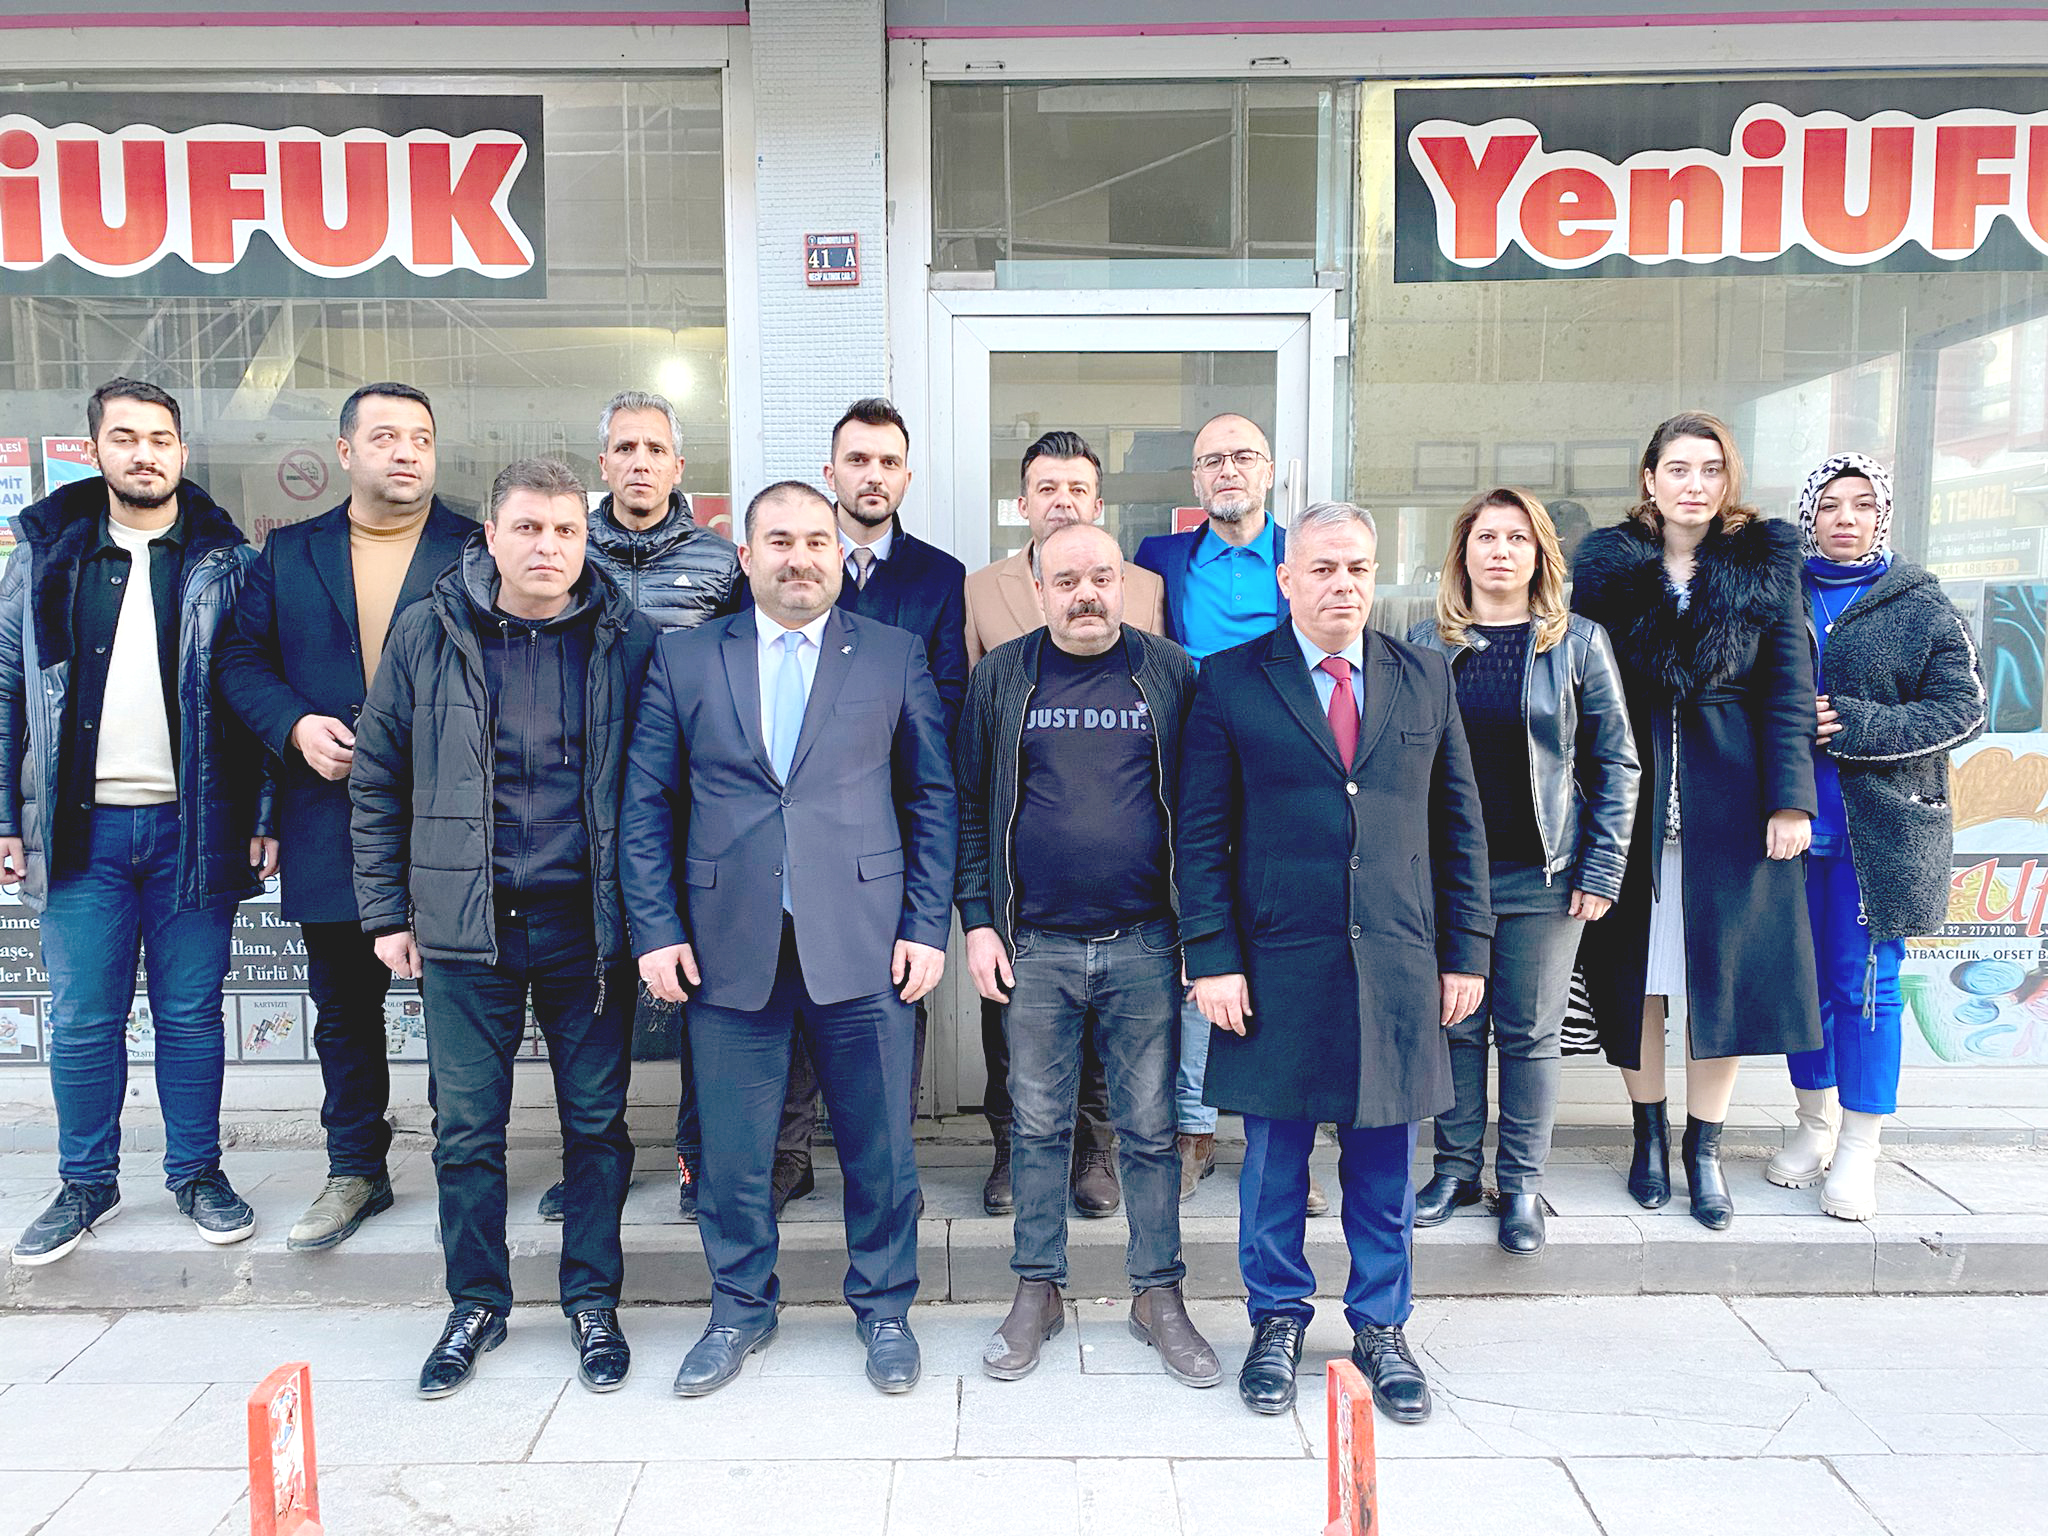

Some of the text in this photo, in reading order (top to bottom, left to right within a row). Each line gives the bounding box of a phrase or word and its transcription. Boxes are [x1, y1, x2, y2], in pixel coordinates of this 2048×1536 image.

[1416, 118, 2048, 260] YeniUF
[808, 247, 856, 269] 41 A
[1027, 708, 1148, 731] JUST DO IT.
[1947, 925, 1961, 936] 32
[1969, 925, 1988, 936] 217
[1989, 925, 2001, 936] 91
[2003, 925, 2017, 936] 00
[1993, 949, 2034, 960] OFSET
[243, 964, 288, 981] Türlü
